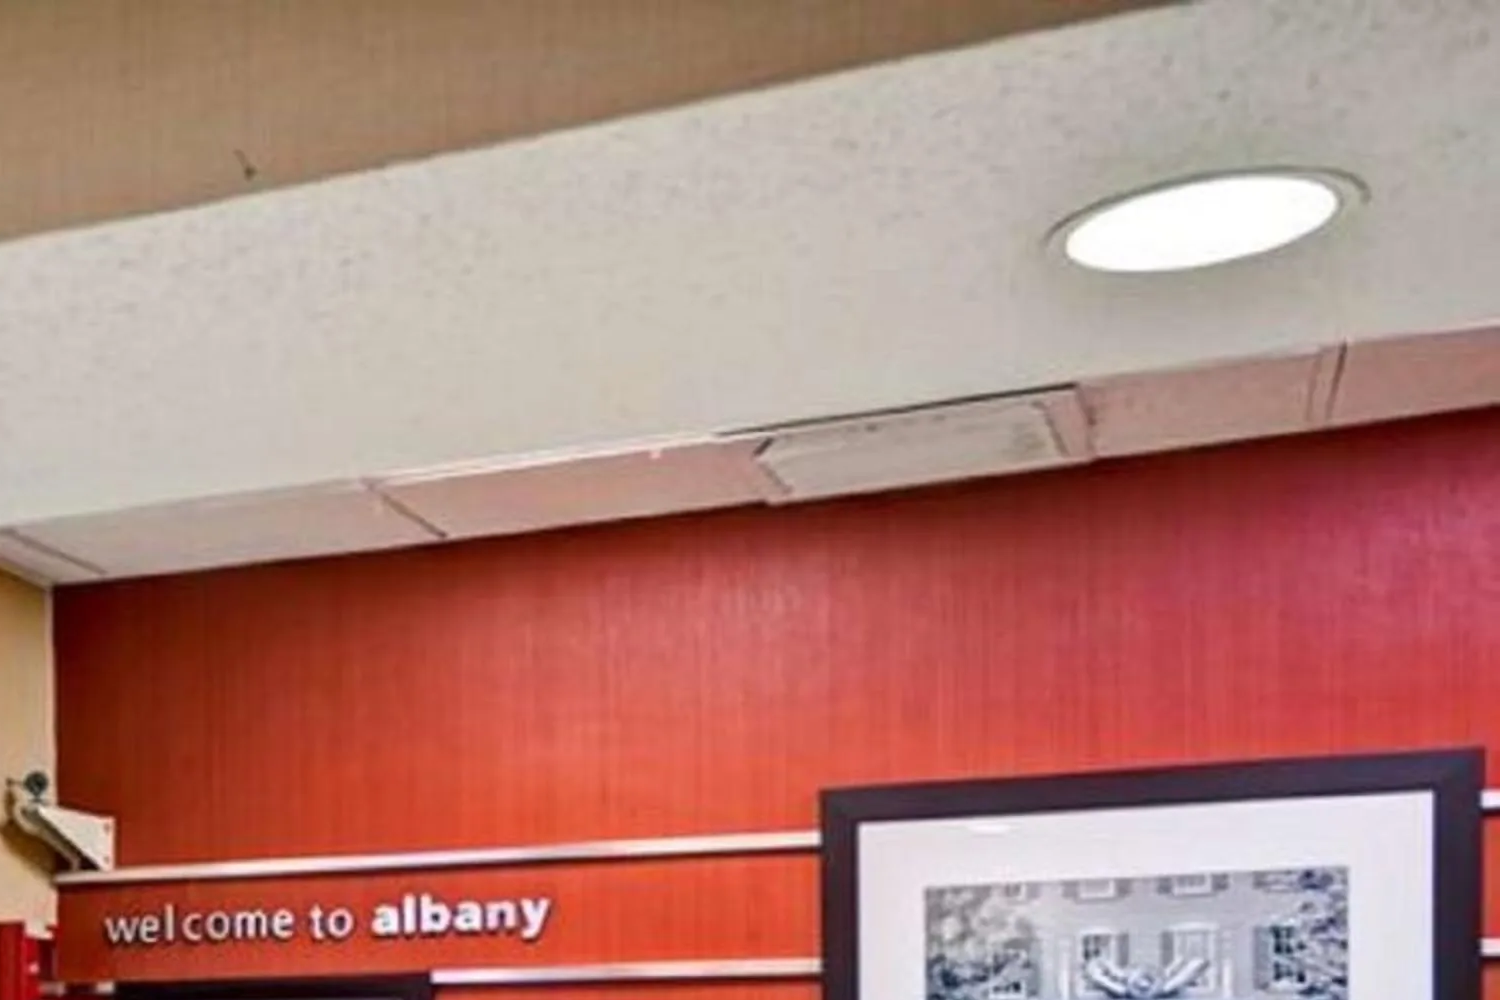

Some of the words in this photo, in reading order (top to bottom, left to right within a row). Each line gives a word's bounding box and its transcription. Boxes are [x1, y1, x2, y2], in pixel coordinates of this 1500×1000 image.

[104, 903, 295, 944] welcome
[309, 903, 354, 941] to
[372, 892, 552, 941] albany
